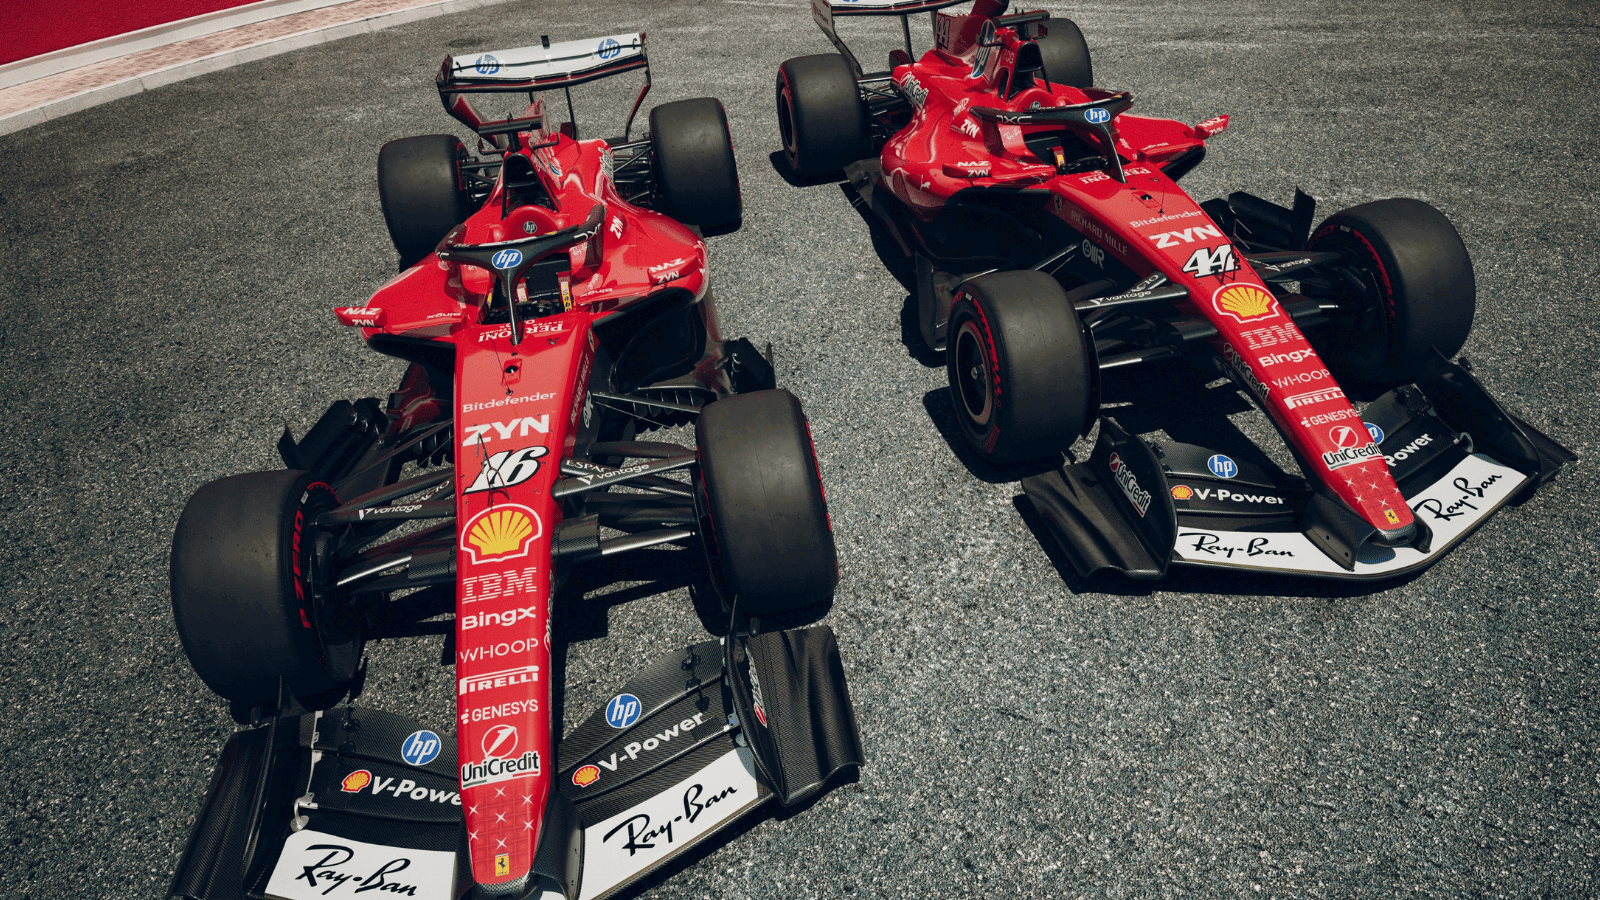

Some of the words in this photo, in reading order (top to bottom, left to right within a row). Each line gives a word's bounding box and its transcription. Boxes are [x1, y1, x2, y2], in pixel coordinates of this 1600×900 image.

[600, 39, 619, 59] hp
[478, 54, 499, 74] hp
[1088, 108, 1107, 123] hp
[960, 119, 980, 139] ZYN
[525, 221, 536, 233] hp
[1130, 210, 1202, 228] Bitdefender
[1104, 233, 1128, 256] MILLE
[1149, 224, 1223, 249] ZYN
[496, 249, 519, 269] hp
[1182, 244, 1241, 279] 44
[1106, 291, 1151, 301] vantage
[478, 324, 563, 342] PERONI
[1240, 322, 1304, 350] IBM
[1272, 369, 1330, 388] WHOOP
[463, 392, 556, 413] Bitdefender
[1284, 386, 1346, 409] PIRELLI
[1310, 409, 1359, 426] GENESYS
[462, 414, 549, 447] ZYN
[1384, 432, 1434, 468] Power
[462, 446, 549, 495] 16
[596, 464, 650, 480] vantage
[1213, 455, 1233, 478] hp
[1119, 460, 1150, 511] UniCredit
[1194, 488, 1285, 505] V-Power
[1413, 474, 1502, 522] Ray-Ban
[374, 504, 423, 515] vantage
[293, 509, 305, 600] ZERO
[1179, 532, 1295, 559] Ray-Ban
[462, 567, 537, 604] IBM
[460, 638, 539, 663] WHOOP
[459, 665, 539, 696] PIRELLI
[471, 699, 538, 722] GENESYS
[610, 694, 638, 728] hp
[405, 730, 438, 766] hp
[599, 712, 703, 772] V-Power
[462, 752, 539, 782] UniCredit
[371, 776, 462, 805] V-Powe
[603, 784, 738, 856] Ray-Ban
[295, 844, 418, 896] Ray-Ban
